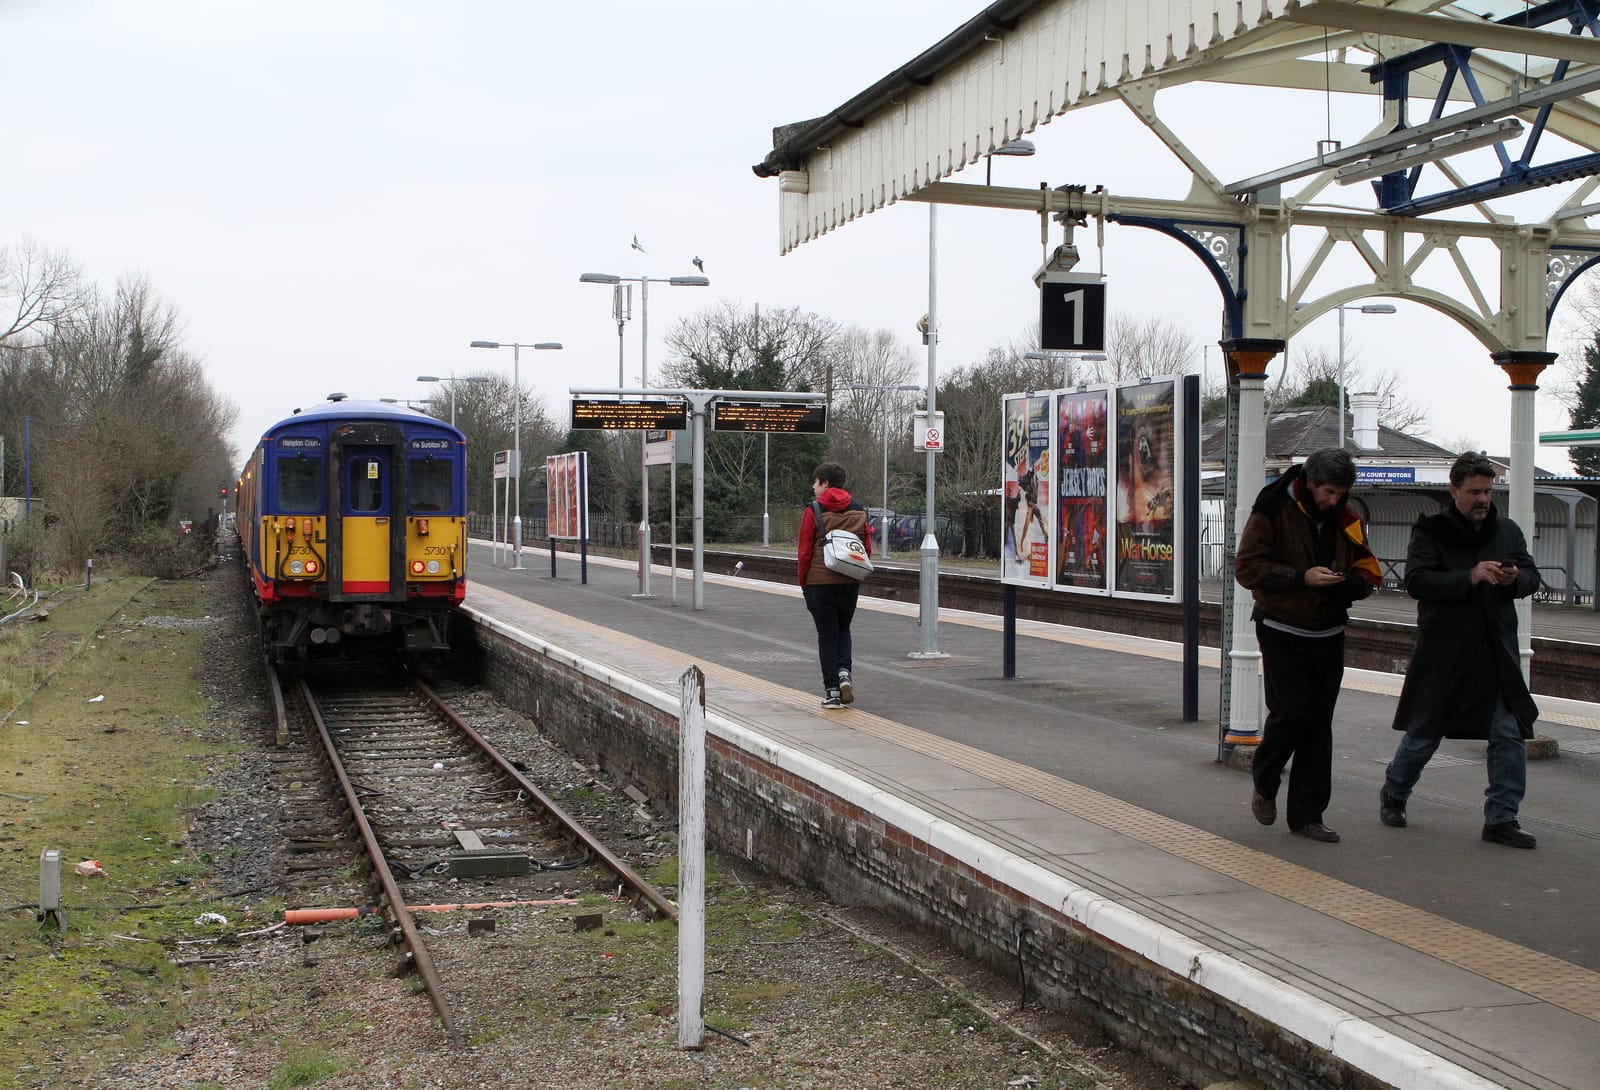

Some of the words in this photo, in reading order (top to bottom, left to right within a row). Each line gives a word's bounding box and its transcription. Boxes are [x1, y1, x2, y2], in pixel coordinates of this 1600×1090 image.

[1064, 289, 1084, 345] 1
[282, 439, 304, 447] Hampton
[420, 441, 440, 449] Surbiton
[441, 441, 448, 449] 30
[1008, 413, 1025, 457] 39
[1061, 468, 1086, 497] JERSEY
[1086, 467, 1106, 497] BOYS
[424, 546, 446, 556] 5730
